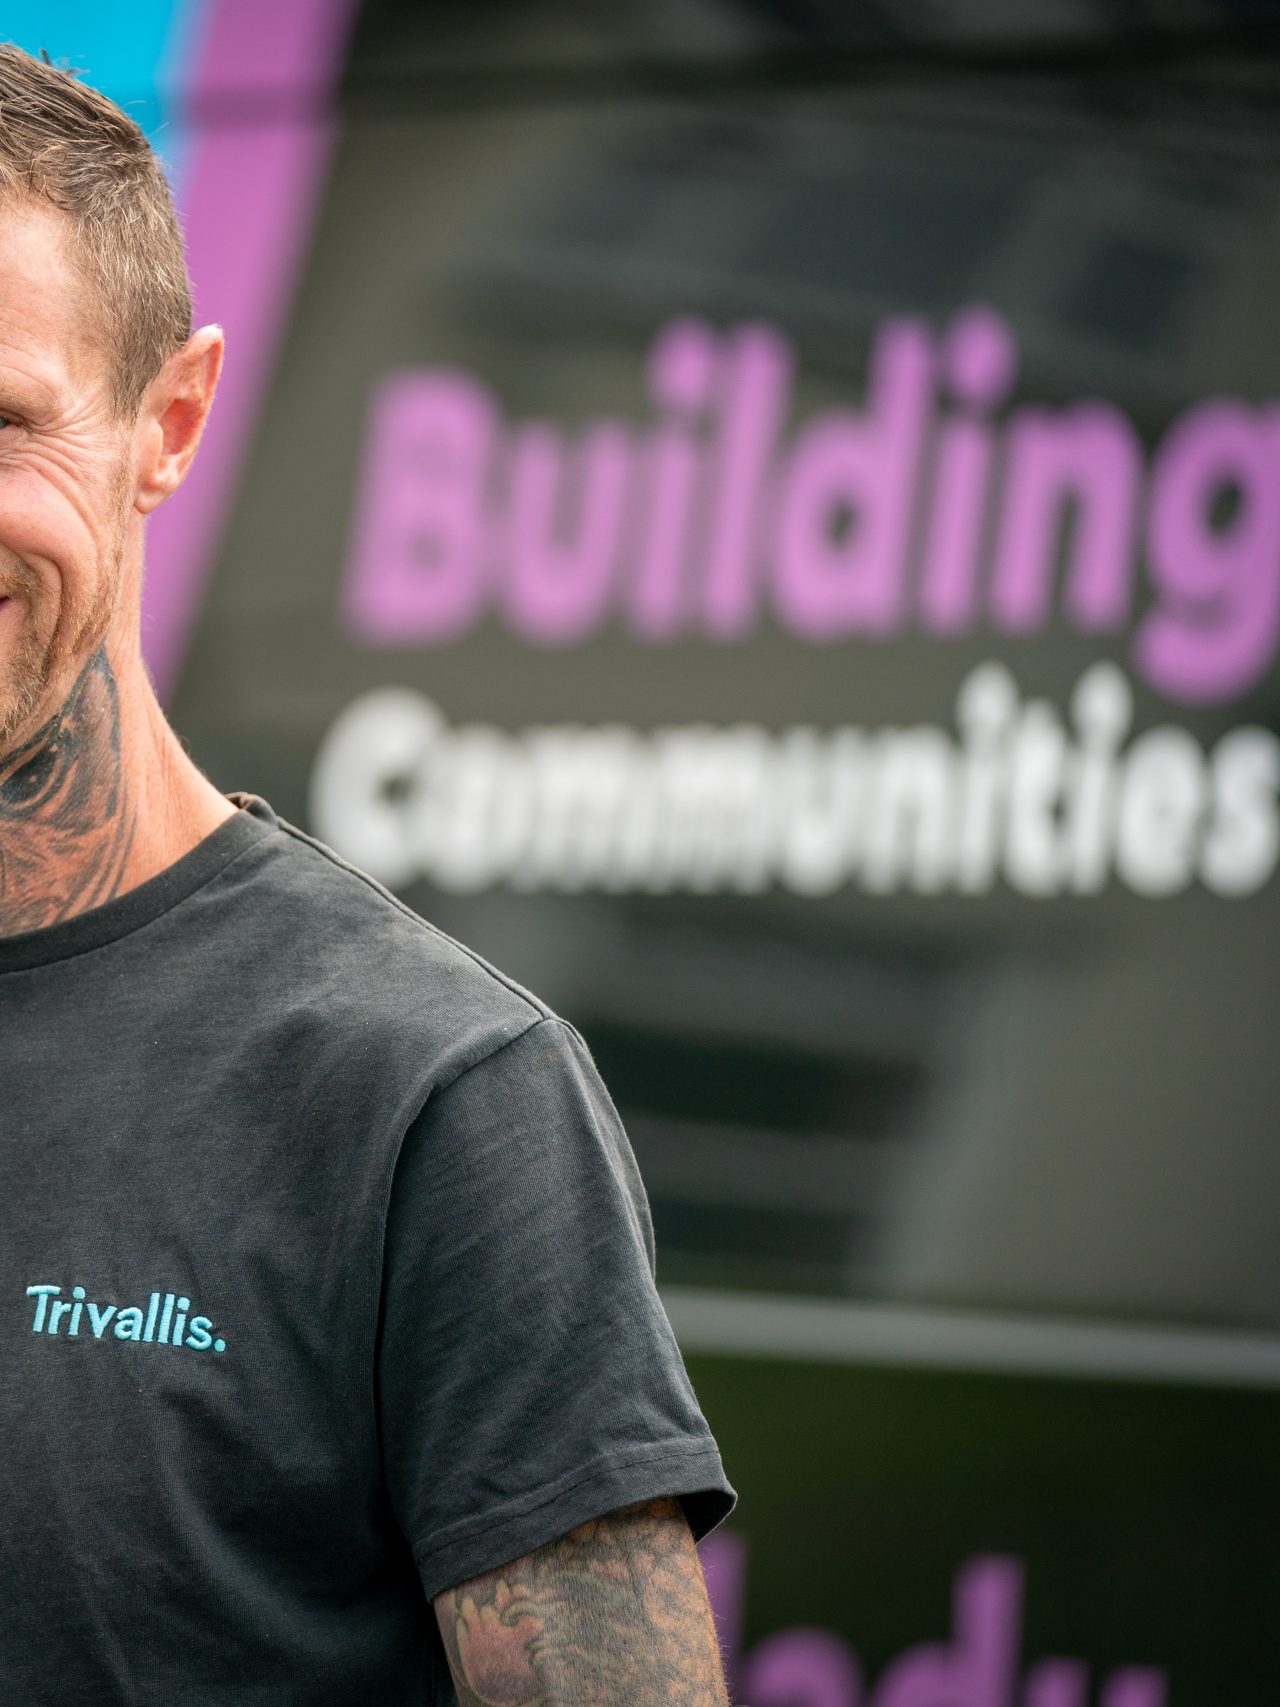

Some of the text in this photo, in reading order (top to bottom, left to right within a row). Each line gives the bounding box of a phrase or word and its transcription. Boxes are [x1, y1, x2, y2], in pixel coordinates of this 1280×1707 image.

[346, 308, 1280, 702] Building
[314, 664, 1280, 892] Communities
[26, 1284, 226, 1352] Trivallis.
